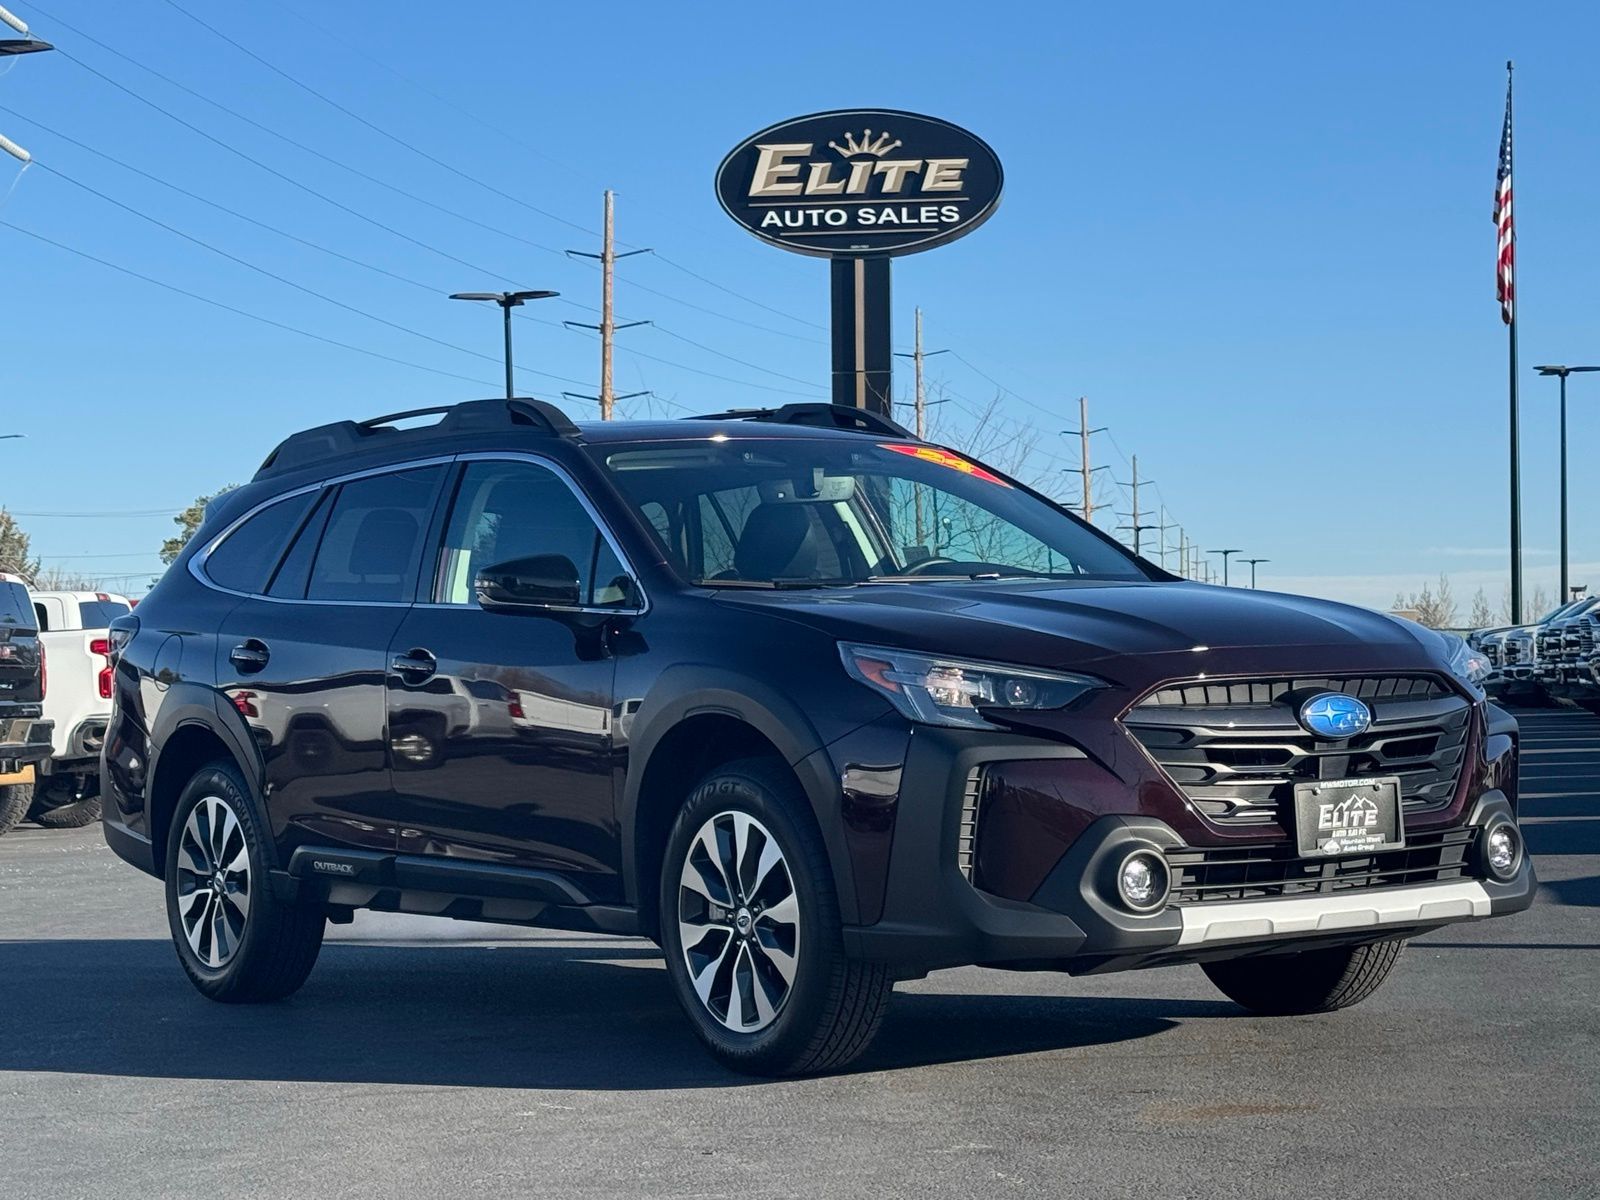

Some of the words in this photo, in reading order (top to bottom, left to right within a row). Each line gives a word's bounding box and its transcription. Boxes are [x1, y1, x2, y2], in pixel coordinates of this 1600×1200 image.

[748, 143, 969, 196] ELITE
[761, 208, 847, 228] AUTO
[857, 206, 959, 225] SALES
[719, 781, 741, 794] GT
[1319, 804, 1378, 829] ELITE
[313, 861, 353, 874] OUTBACK
